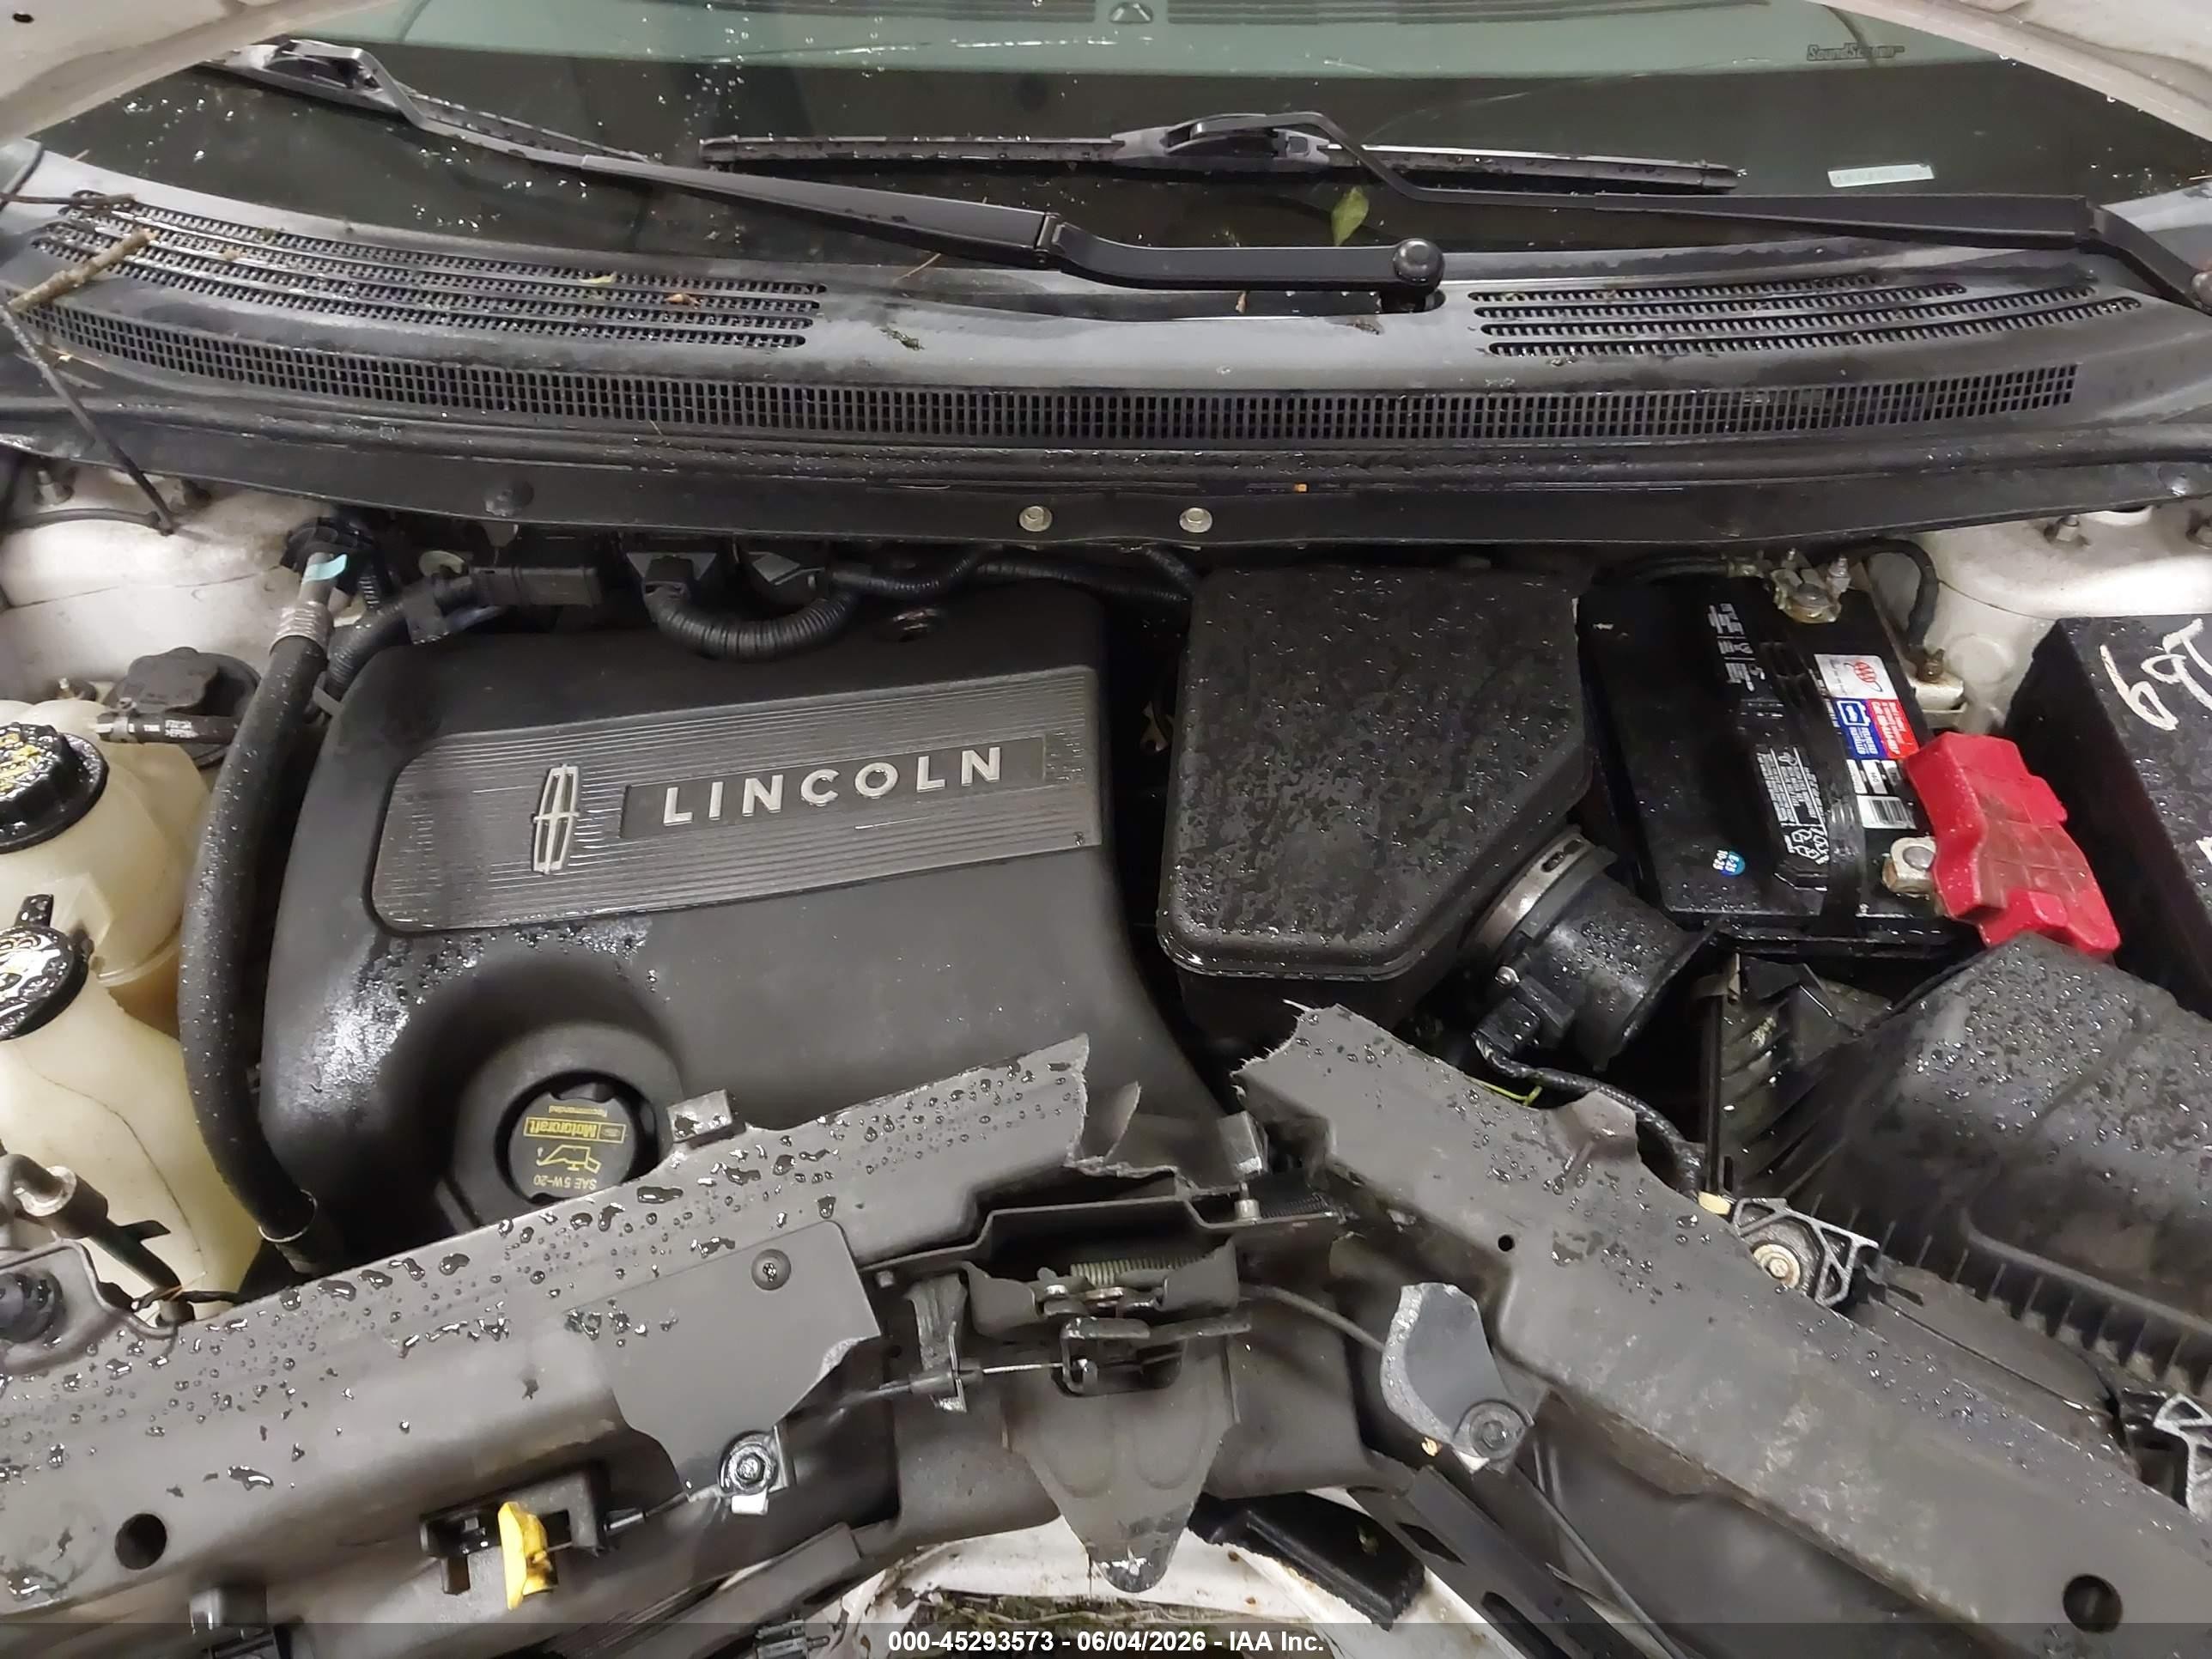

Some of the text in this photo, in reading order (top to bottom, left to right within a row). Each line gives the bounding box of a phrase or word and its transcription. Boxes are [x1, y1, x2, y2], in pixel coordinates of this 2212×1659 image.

[1807, 43, 1896, 61] SoundSceen
[662, 746, 1001, 827] LINCOLN
[549, 1105, 608, 1118] Recommended
[530, 1120, 598, 1139] Motorcraft
[574, 1177, 598, 1191] SAE
